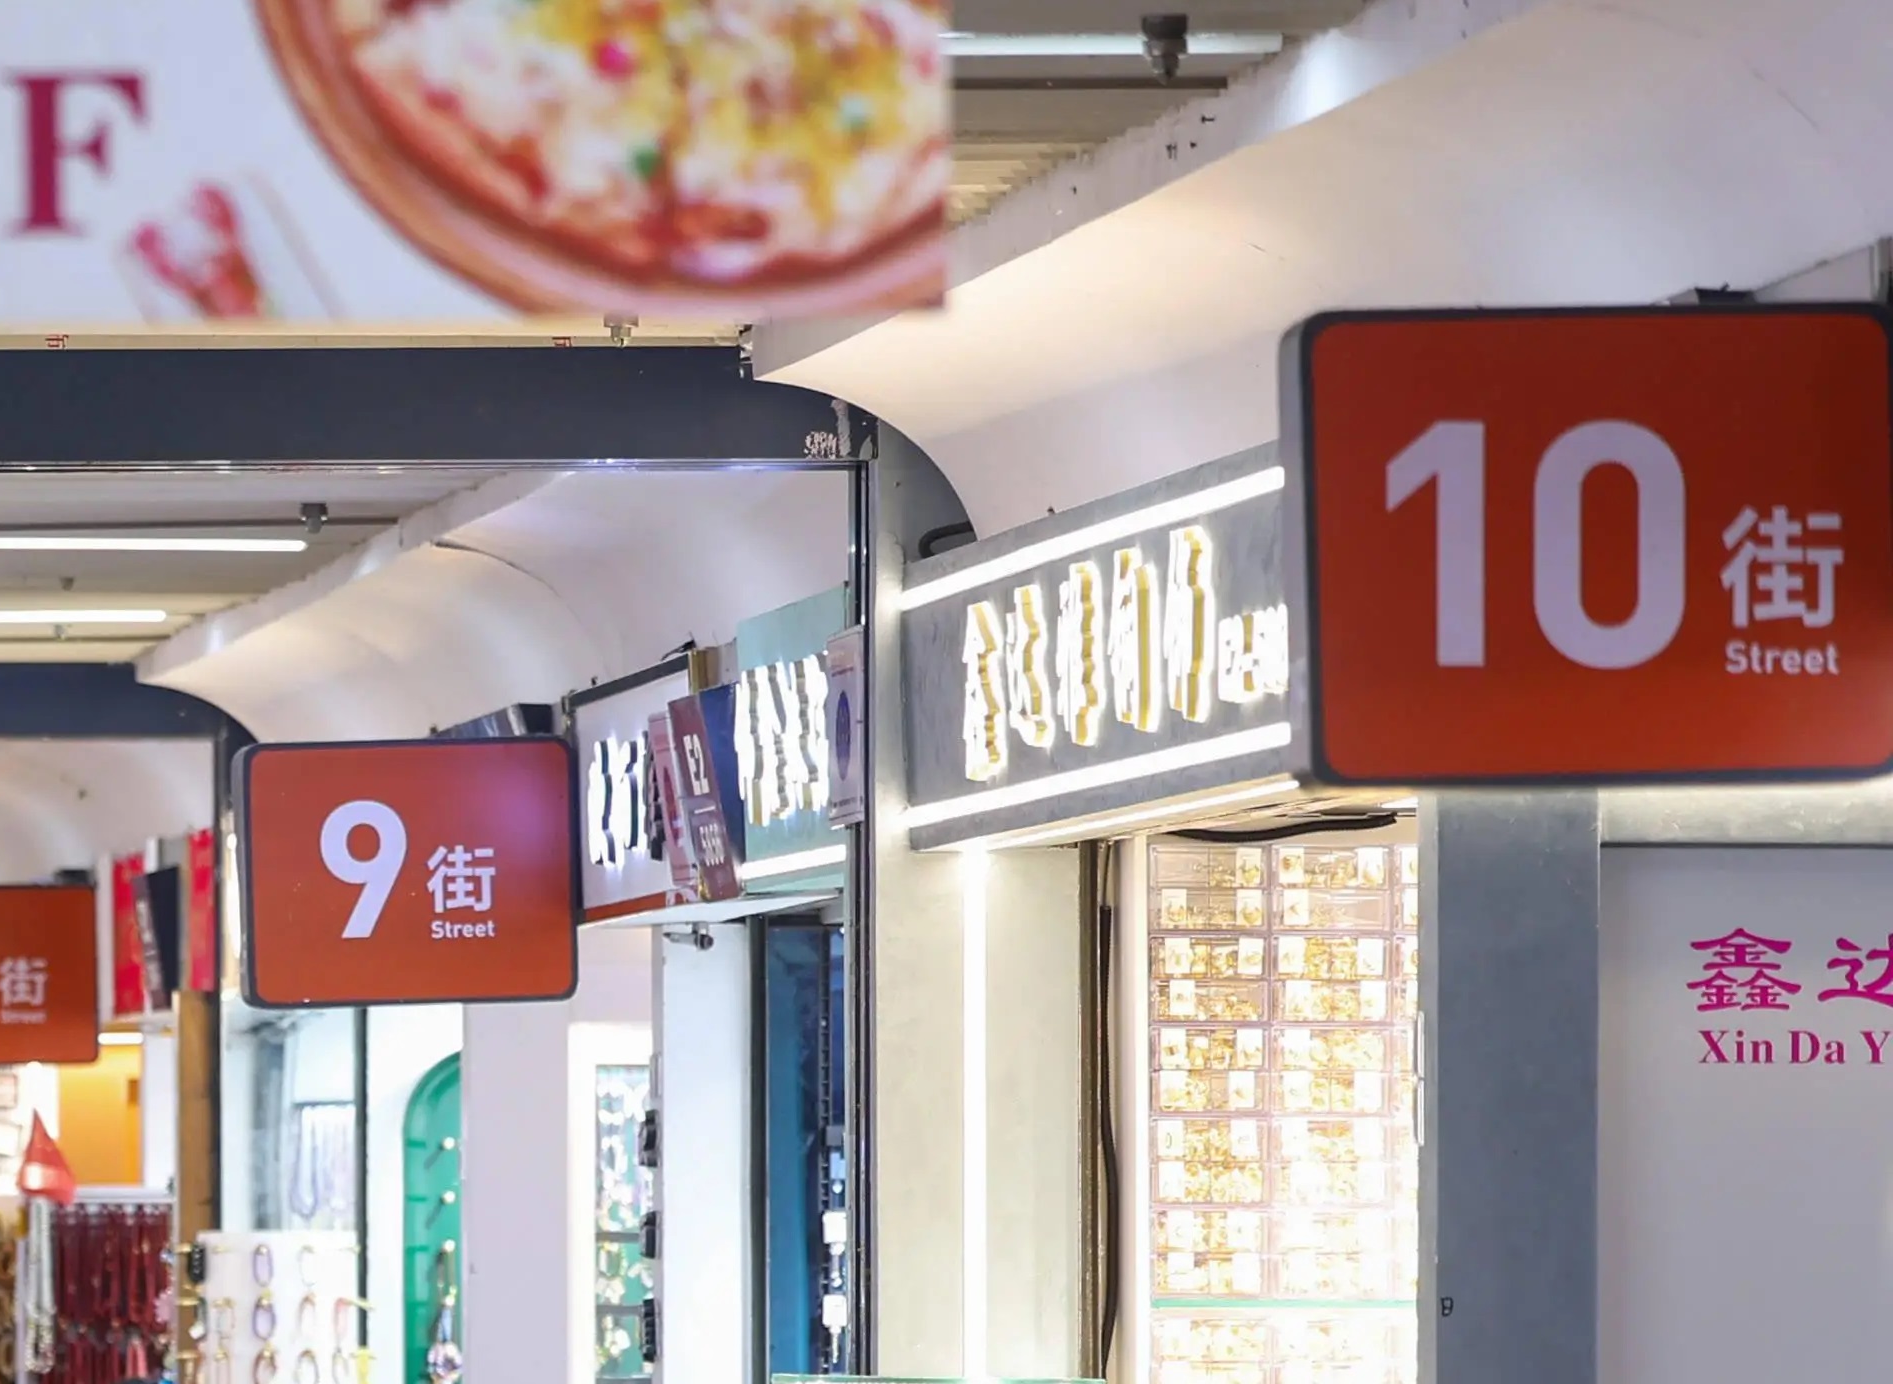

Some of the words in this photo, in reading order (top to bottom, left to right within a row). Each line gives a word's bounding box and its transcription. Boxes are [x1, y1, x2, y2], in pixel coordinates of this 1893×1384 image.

[1385, 420, 1687, 671] 10
[1720, 507, 1845, 630] 街
[1725, 641, 1841, 676] Street
[683, 733, 711, 796] E2
[319, 800, 408, 938] 9
[426, 845, 497, 914] 街
[430, 919, 496, 940] Street
[1698, 1029, 1774, 1064] Xin
[1789, 1029, 1846, 1064] Da
